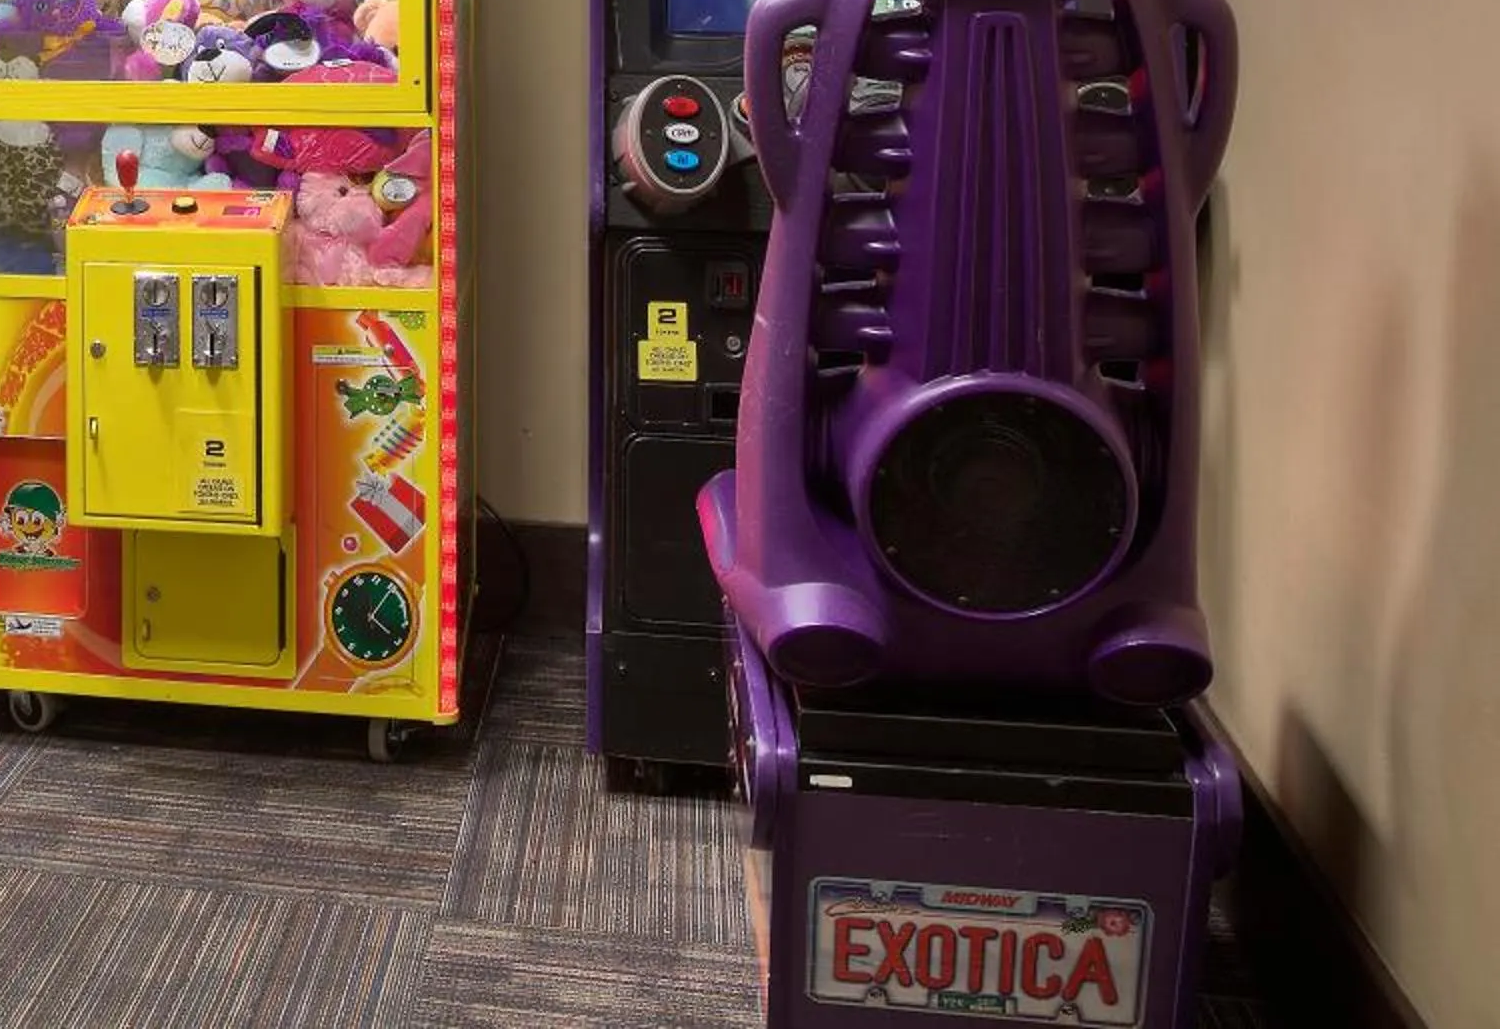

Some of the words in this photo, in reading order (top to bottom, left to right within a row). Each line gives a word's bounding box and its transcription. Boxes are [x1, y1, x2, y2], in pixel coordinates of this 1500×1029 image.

[658, 308, 676, 324] 2
[205, 440, 225, 457] 2
[940, 891, 1023, 909] MIDWAY
[831, 916, 1120, 1007] EXOTICA
